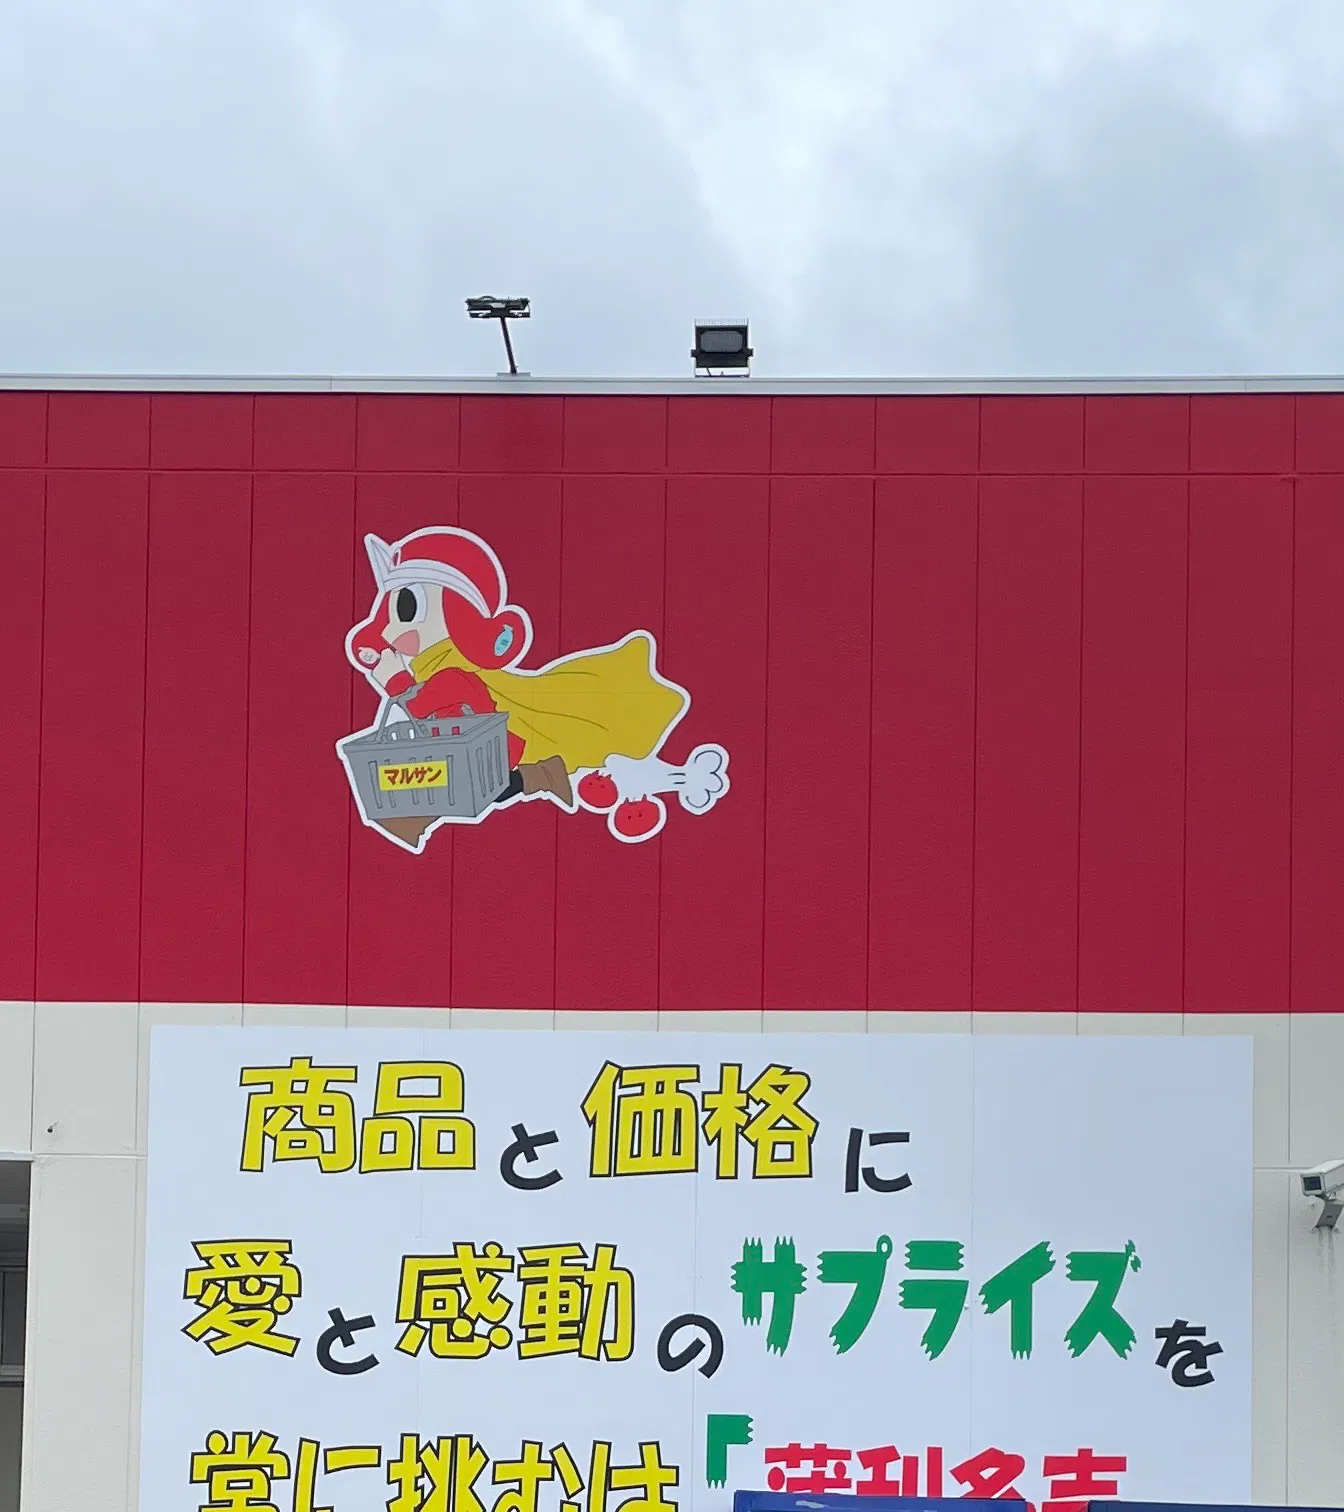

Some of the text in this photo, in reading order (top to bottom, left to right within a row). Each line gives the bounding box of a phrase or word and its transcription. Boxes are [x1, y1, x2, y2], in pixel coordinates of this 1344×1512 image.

[383, 766, 442, 786] マルサン
[239, 1056, 913, 1194] 商品と価格に
[181, 1234, 1224, 1388] 愛と感動のサプライズを
